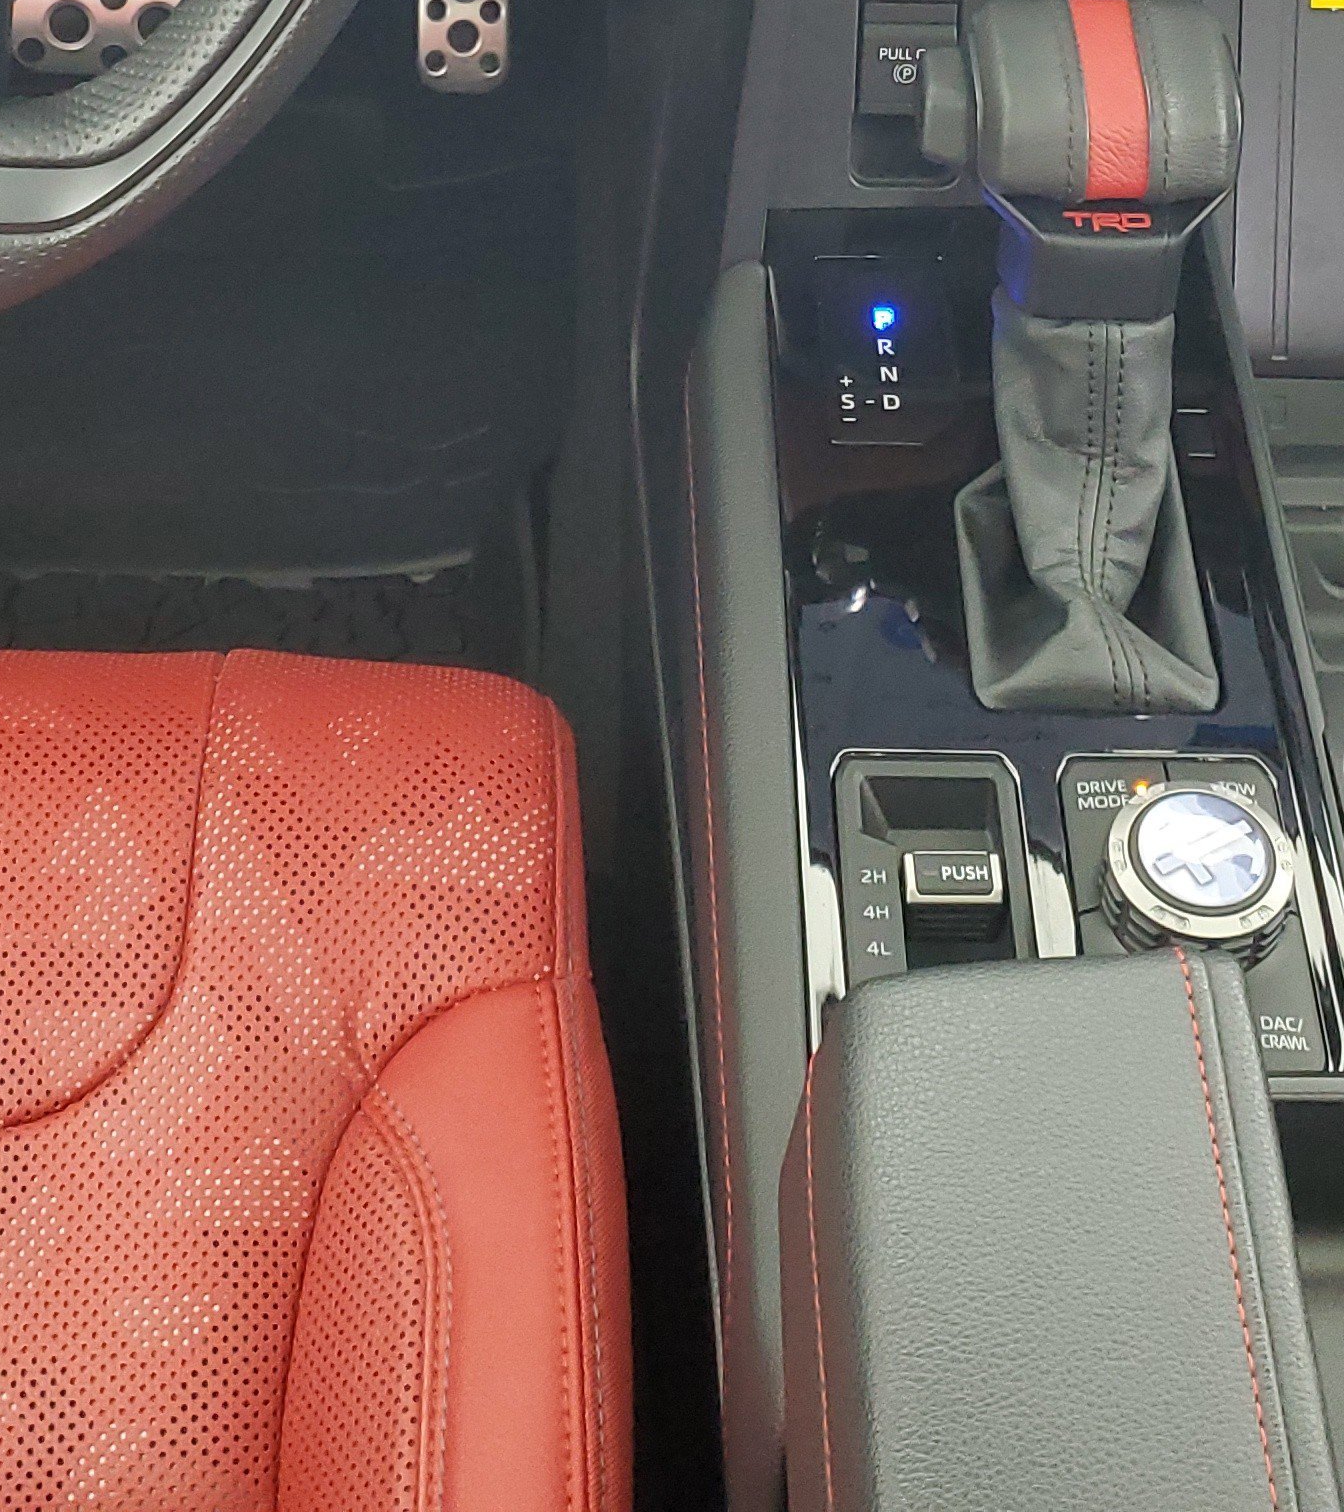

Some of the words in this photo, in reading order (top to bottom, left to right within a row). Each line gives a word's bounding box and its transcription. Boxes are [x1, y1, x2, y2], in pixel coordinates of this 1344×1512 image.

[879, 47, 913, 61] PULL
[1061, 210, 1152, 233] TRD
[872, 306, 895, 330] P
[877, 338, 895, 356] R
[880, 365, 899, 383] N
[1076, 778, 1128, 795] DRIVE
[860, 868, 887, 886] 2H
[941, 864, 989, 882] PUSH
[862, 904, 889, 921] 4H
[865, 940, 891, 956] 4L
[1260, 1015, 1304, 1034] DAC/
[1260, 1034, 1312, 1052] CRAWL
